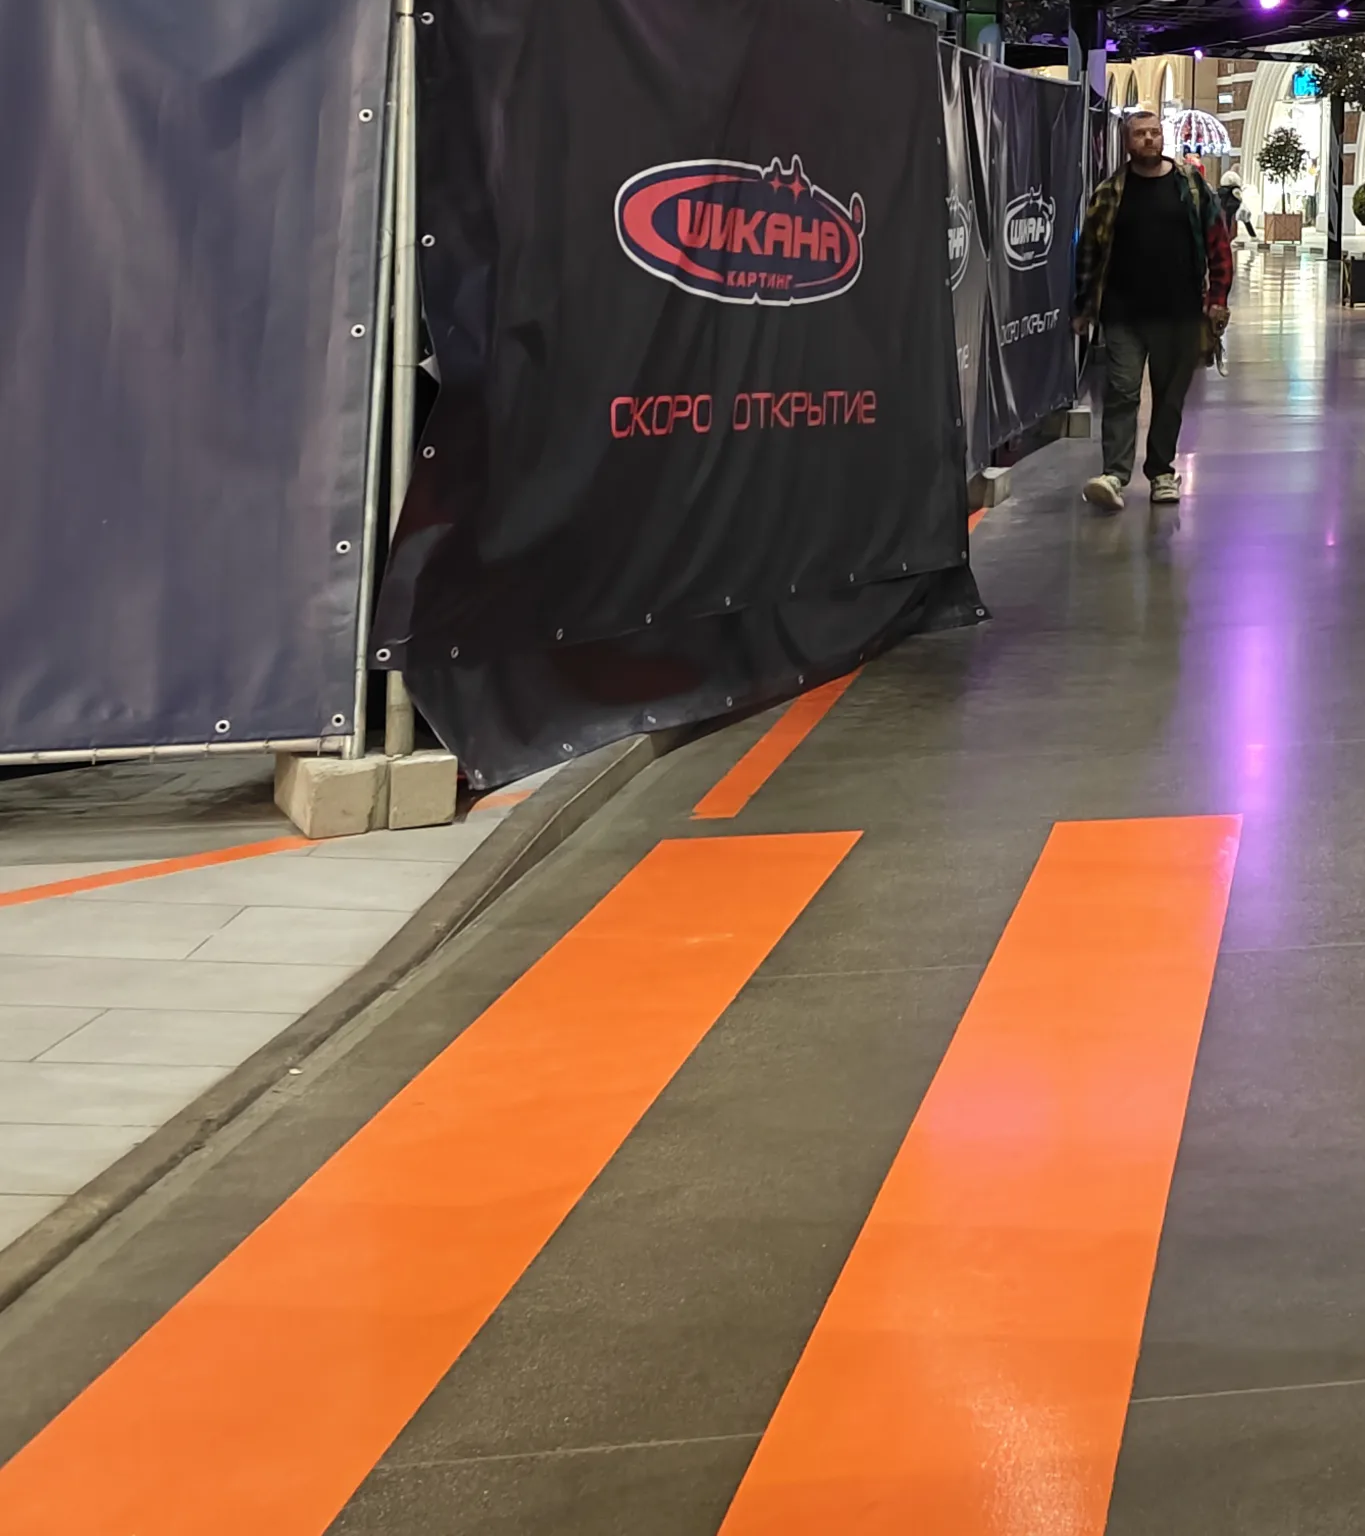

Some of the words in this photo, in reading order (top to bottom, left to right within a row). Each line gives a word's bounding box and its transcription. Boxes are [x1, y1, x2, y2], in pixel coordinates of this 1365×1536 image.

[676, 198, 841, 264] ШИКАНА
[726, 270, 794, 290] КАРТИНГ
[610, 393, 713, 439] СКОРО
[732, 390, 877, 431] ОТКРЫТИЕ
